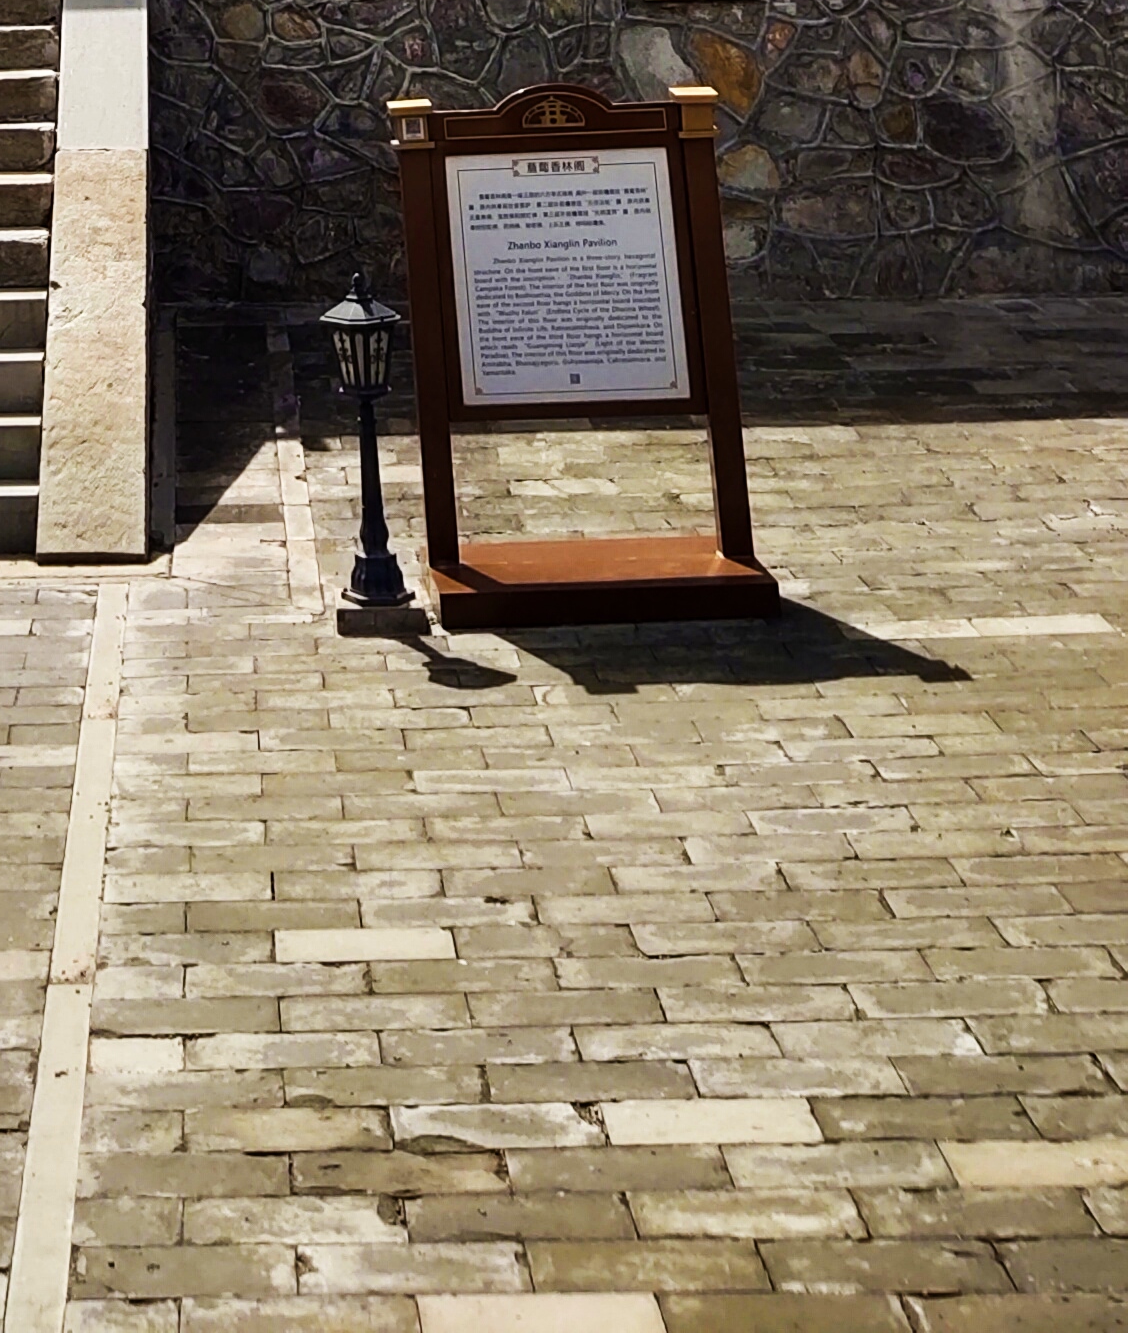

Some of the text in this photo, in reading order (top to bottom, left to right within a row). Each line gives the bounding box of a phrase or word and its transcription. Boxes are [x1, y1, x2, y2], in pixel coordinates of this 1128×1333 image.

[507, 237, 617, 251] Zhanbo Xianglin Pavilion
